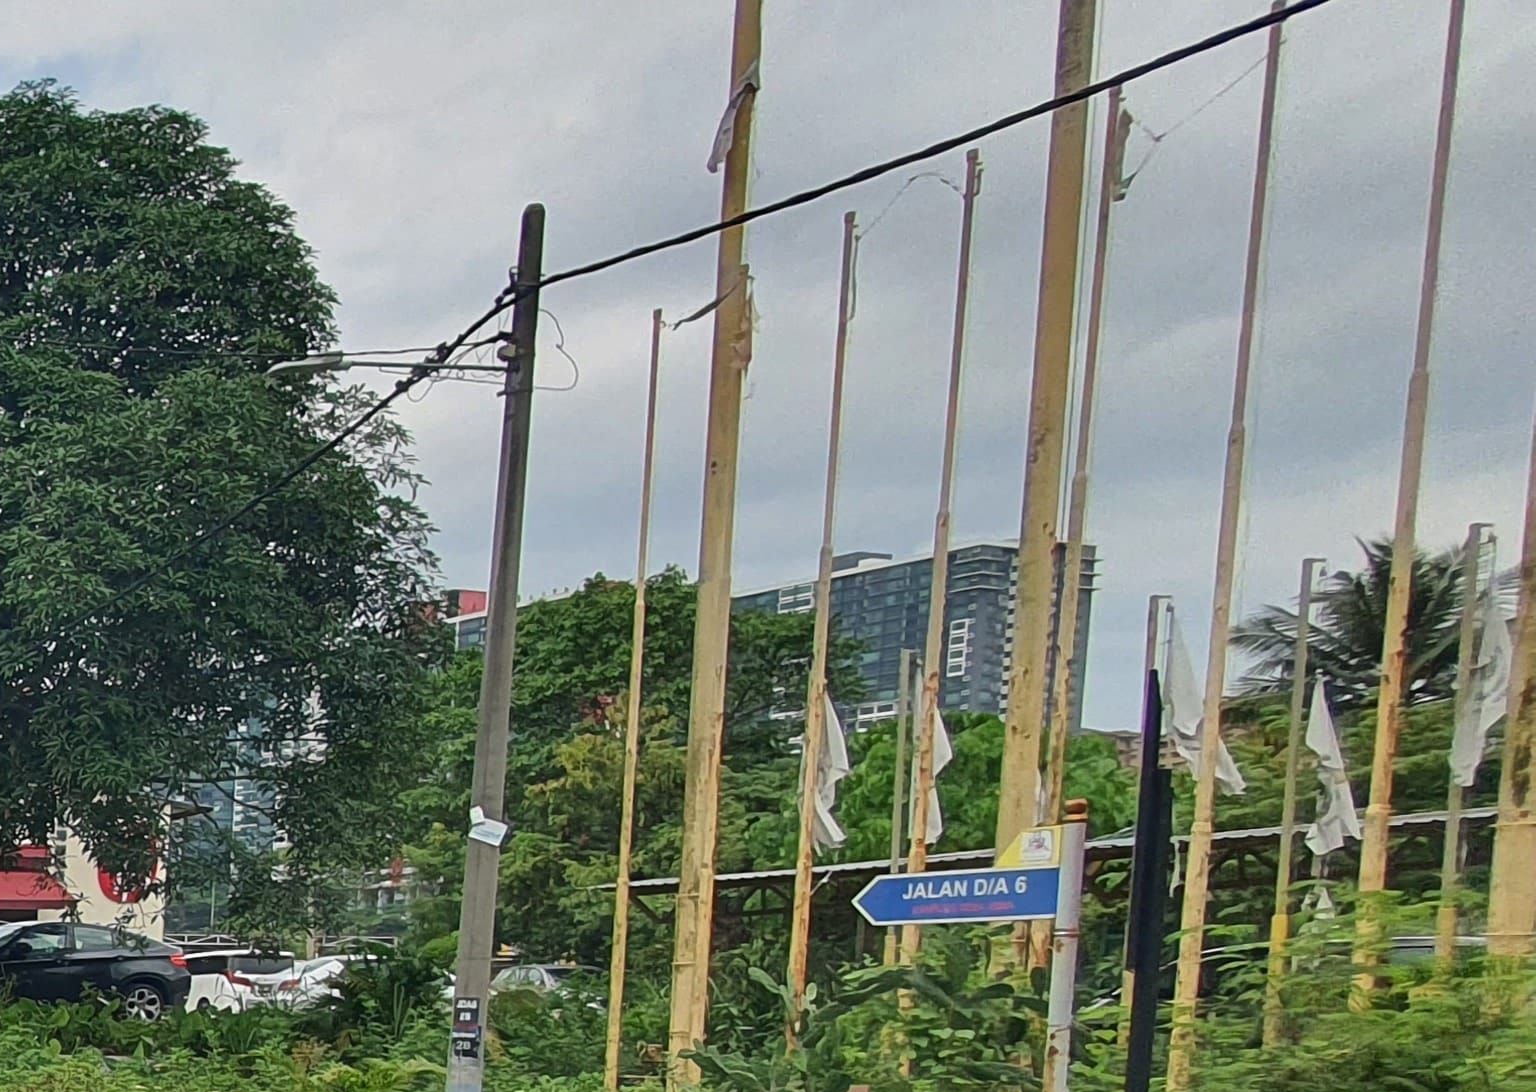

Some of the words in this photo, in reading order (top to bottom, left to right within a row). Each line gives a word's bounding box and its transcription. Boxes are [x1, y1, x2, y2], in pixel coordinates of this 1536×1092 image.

[902, 881, 968, 900] JALAN
[973, 877, 1009, 897] D/A
[1014, 876, 1028, 894] 6
